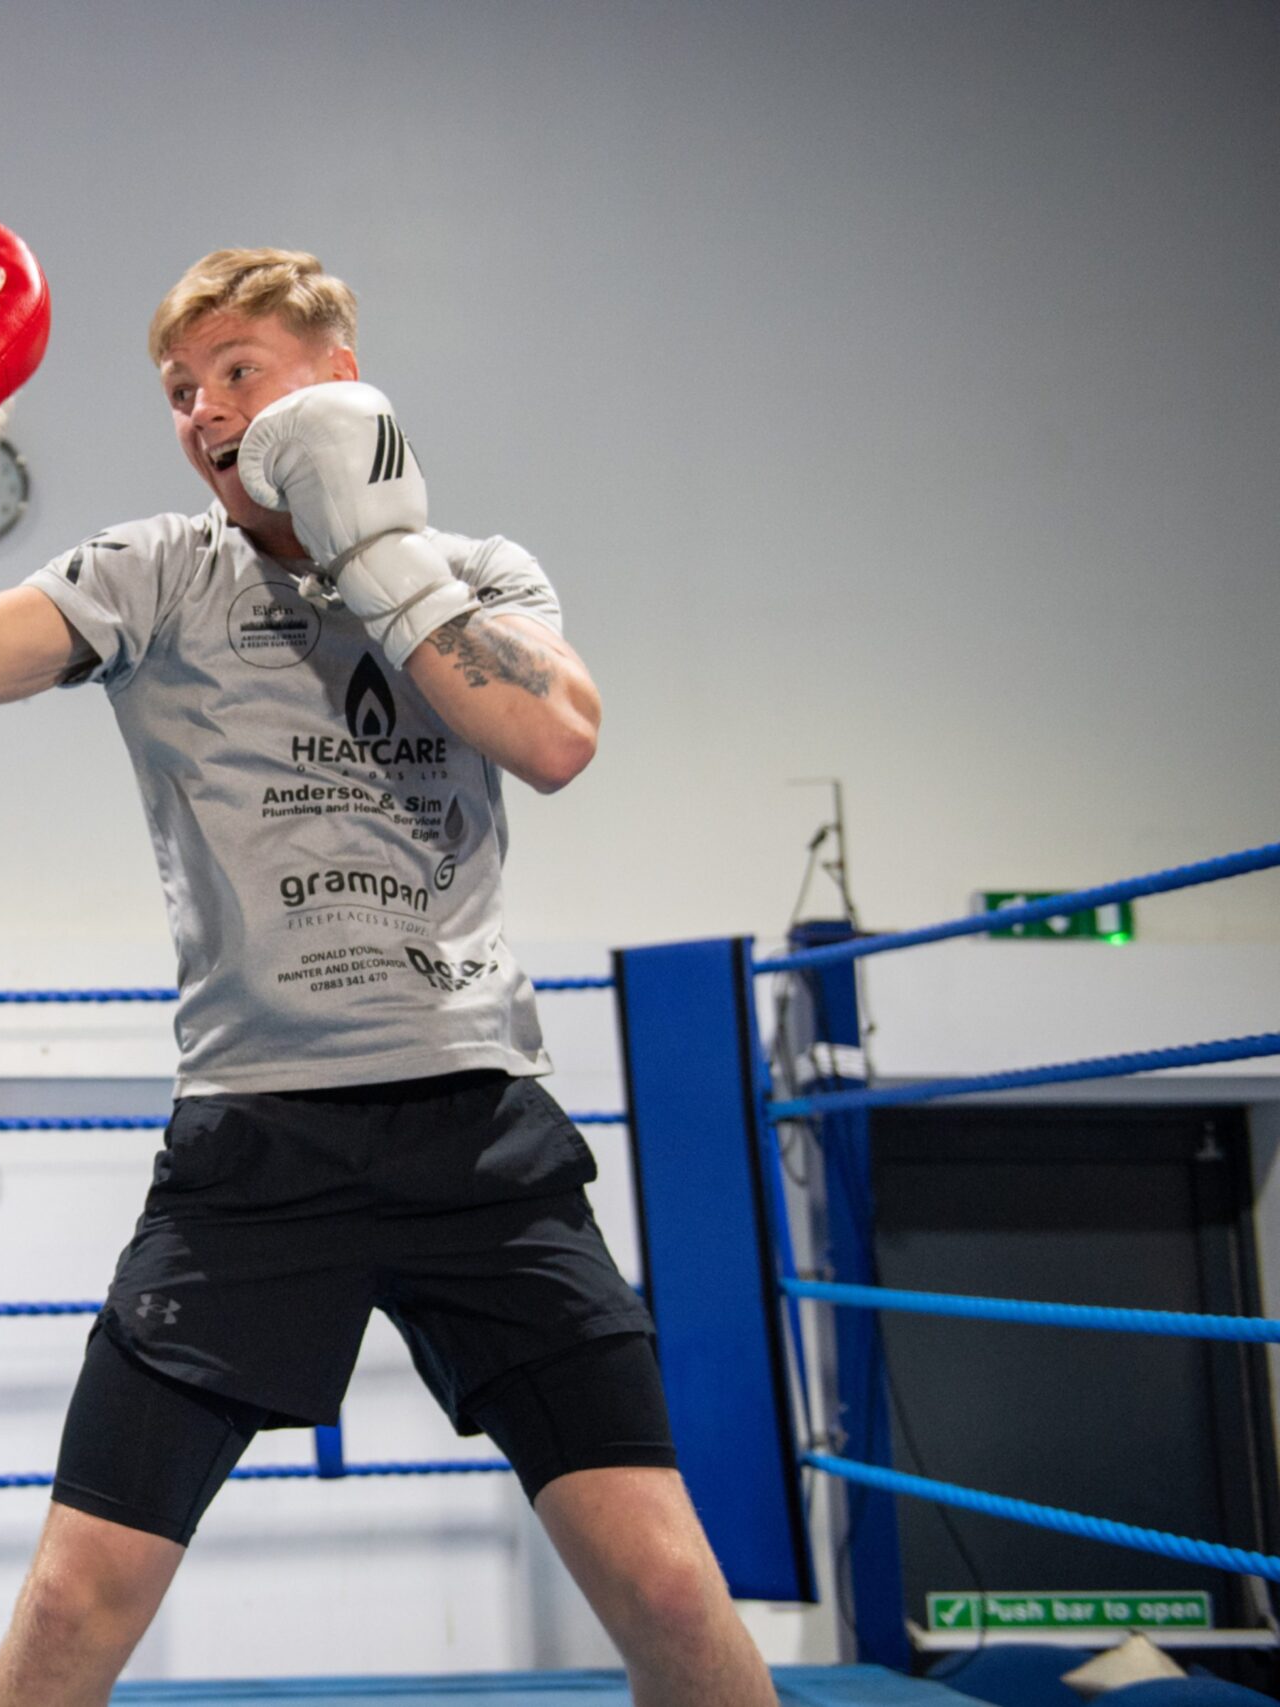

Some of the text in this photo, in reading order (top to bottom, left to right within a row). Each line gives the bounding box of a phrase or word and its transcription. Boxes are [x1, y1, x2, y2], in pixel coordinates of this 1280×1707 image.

[292, 735, 446, 765] HEATCARE
[262, 804, 322, 818] Plumbing
[325, 803, 350, 813] and
[379, 791, 395, 810] &
[404, 795, 442, 814] Sim
[411, 828, 440, 842] Elgin
[288, 910, 379, 930] FIREPLACES
[301, 949, 347, 965] DONALD
[277, 968, 323, 983] PAINTER
[324, 962, 349, 976] AND
[351, 957, 408, 972] DECORATOR
[310, 971, 389, 992] 07883 341 470
[1052, 1600, 1094, 1619] bar
[1104, 1600, 1131, 1619] to
[1138, 1602, 1201, 1622] open
